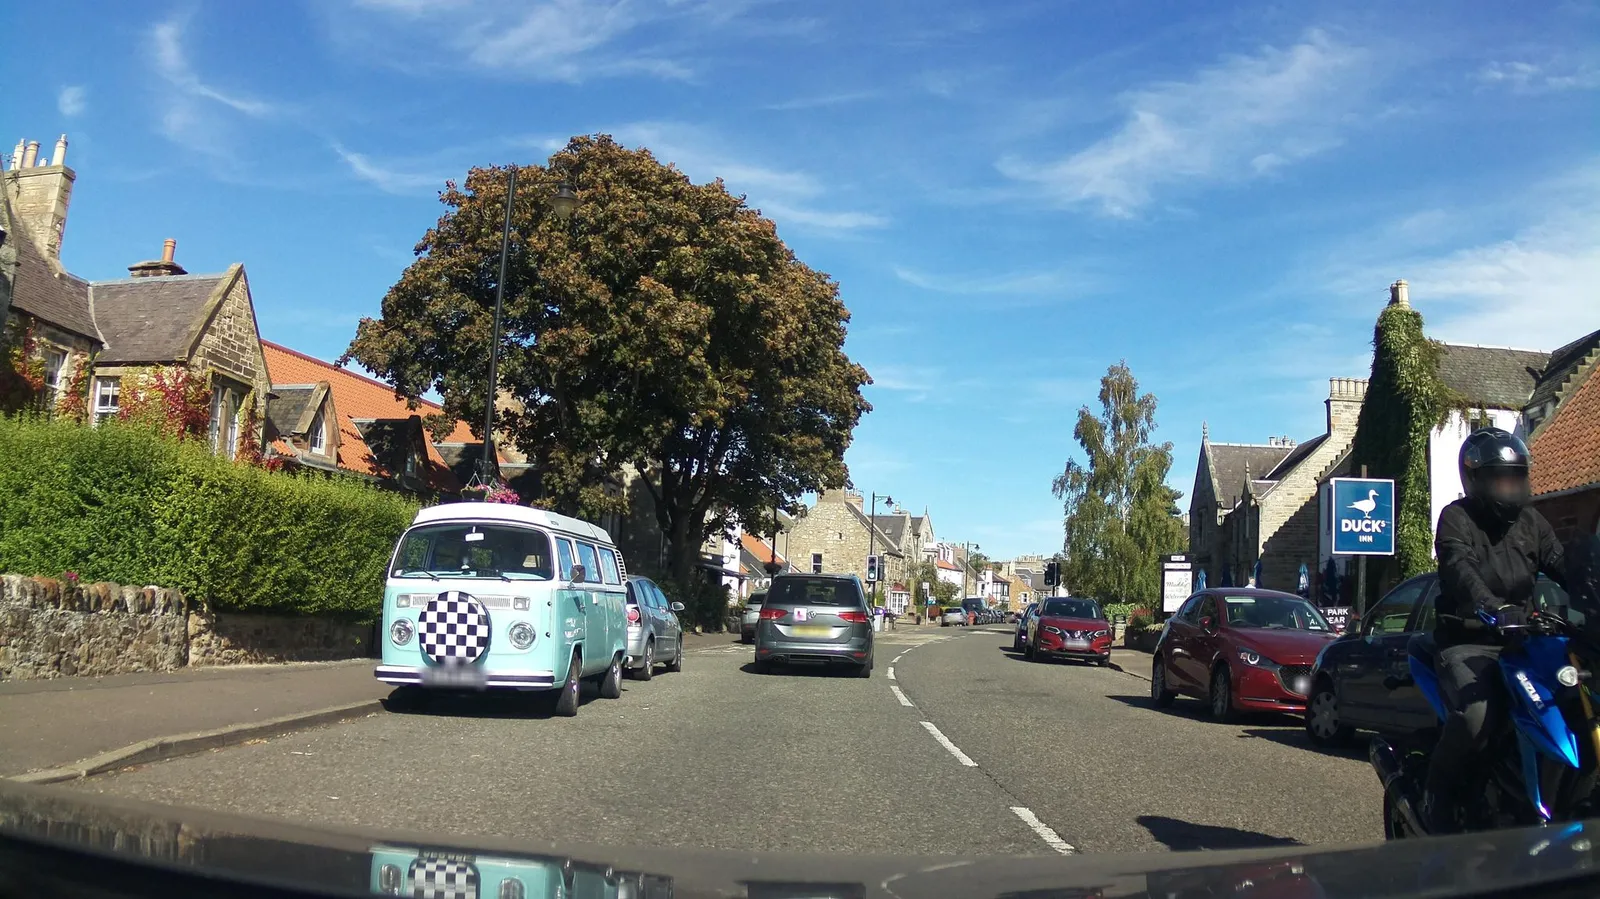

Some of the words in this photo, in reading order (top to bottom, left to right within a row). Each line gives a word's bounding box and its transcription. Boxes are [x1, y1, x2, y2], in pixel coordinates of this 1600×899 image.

[1359, 535, 1373, 543] INN
[1327, 608, 1349, 616] PARK
[1326, 616, 1346, 624] EAR
[1516, 671, 1545, 709] SUZUKI
